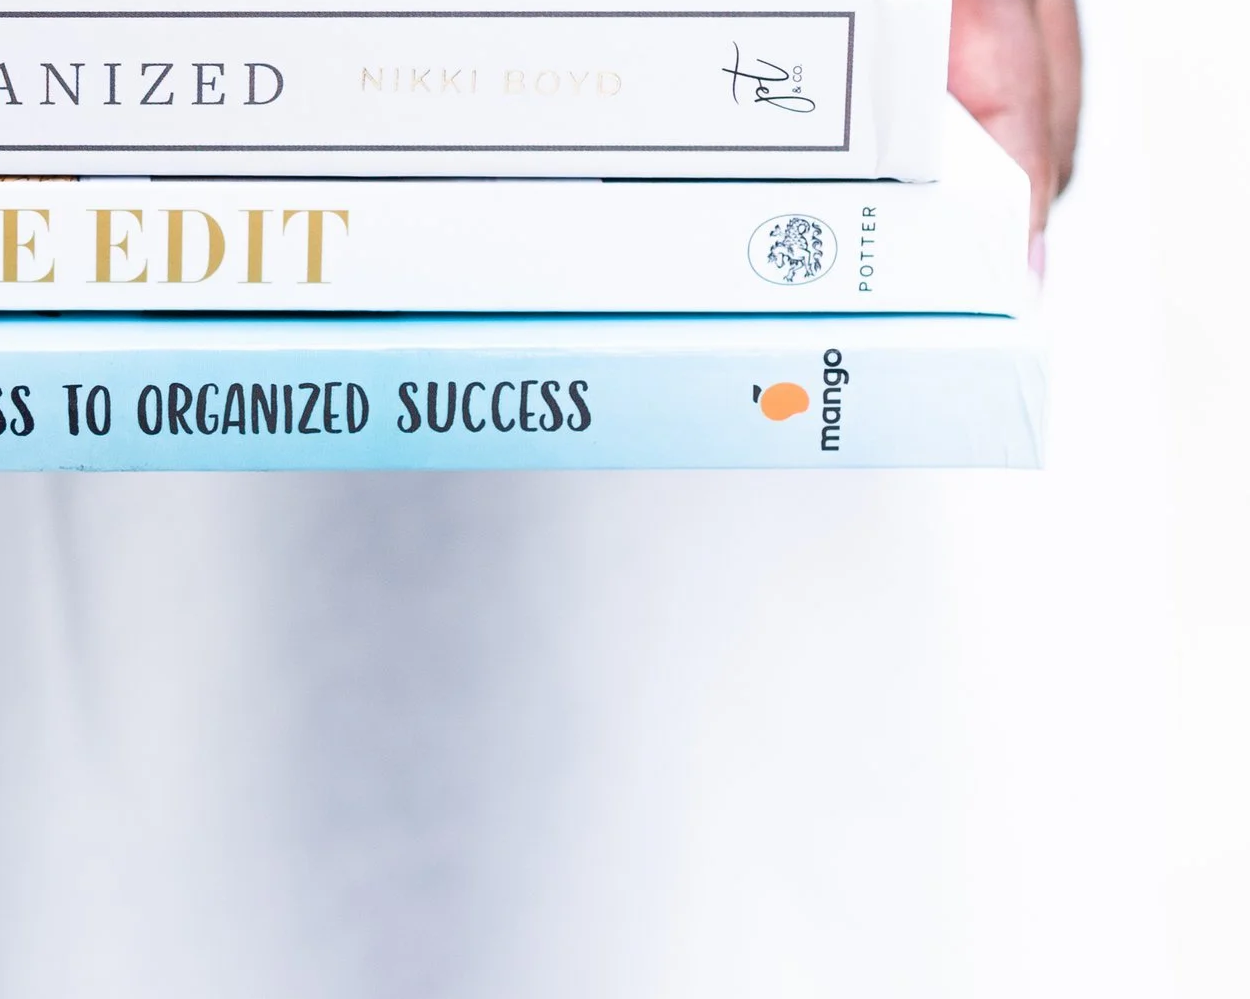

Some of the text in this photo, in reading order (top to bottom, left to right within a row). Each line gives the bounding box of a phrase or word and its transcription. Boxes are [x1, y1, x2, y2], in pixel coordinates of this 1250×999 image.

[359, 67, 622, 97] NIKKI BOYD
[85, 209, 350, 284] EDIT
[858, 206, 877, 292] POTTER
[61, 383, 112, 437] TO
[136, 381, 370, 436] ORGANIZED
[396, 379, 592, 434] SUCCESS
[821, 348, 849, 451] mango
